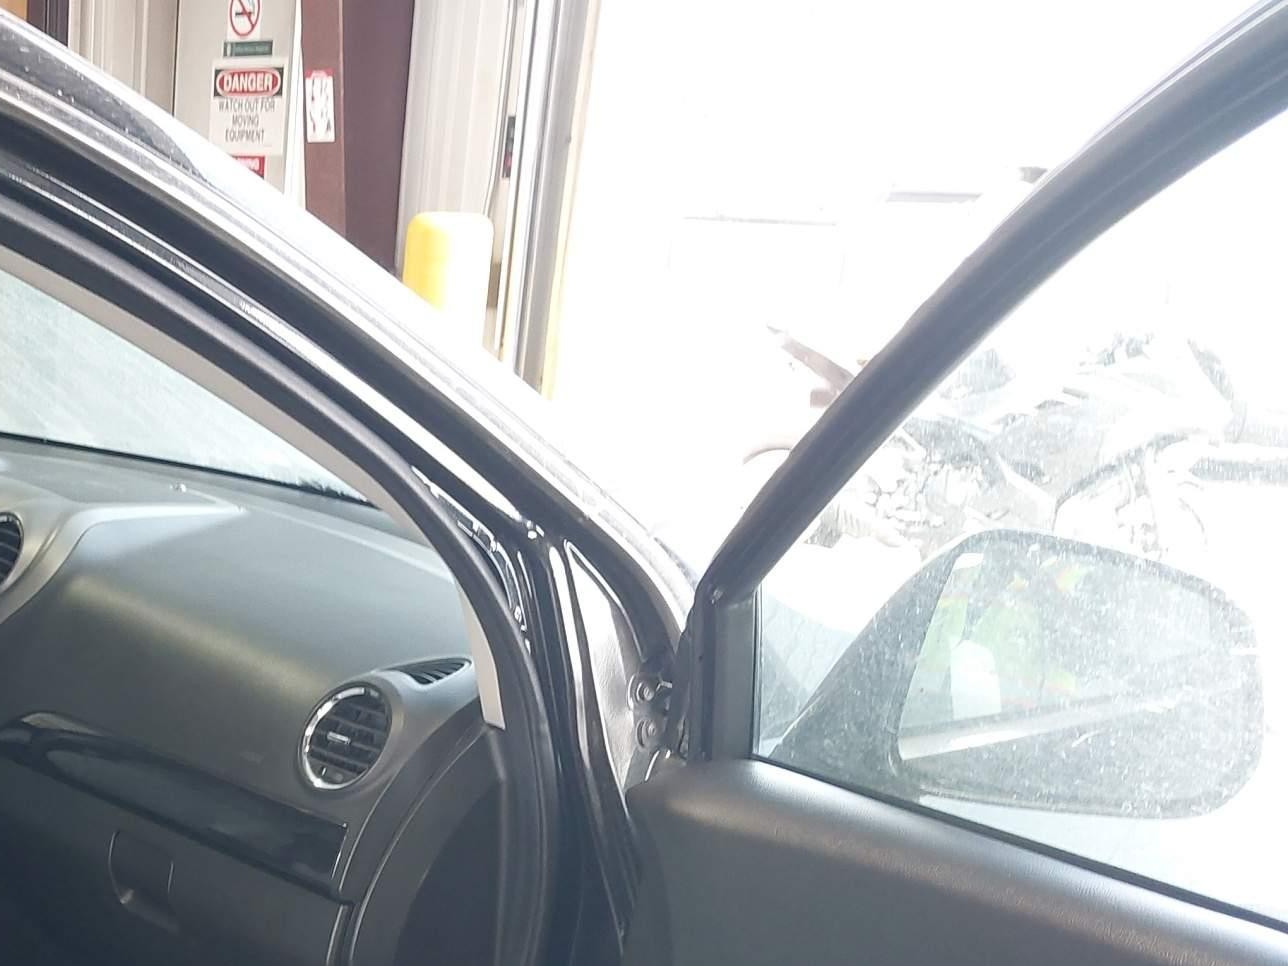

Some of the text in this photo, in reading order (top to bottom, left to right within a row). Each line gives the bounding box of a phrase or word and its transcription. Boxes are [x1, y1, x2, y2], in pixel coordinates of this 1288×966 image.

[223, 73, 273, 92] DANGER
[219, 99, 275, 112] WATCH OUT FOR
[232, 115, 259, 127] MOVING
[225, 130, 265, 143] EQUIPMENT
